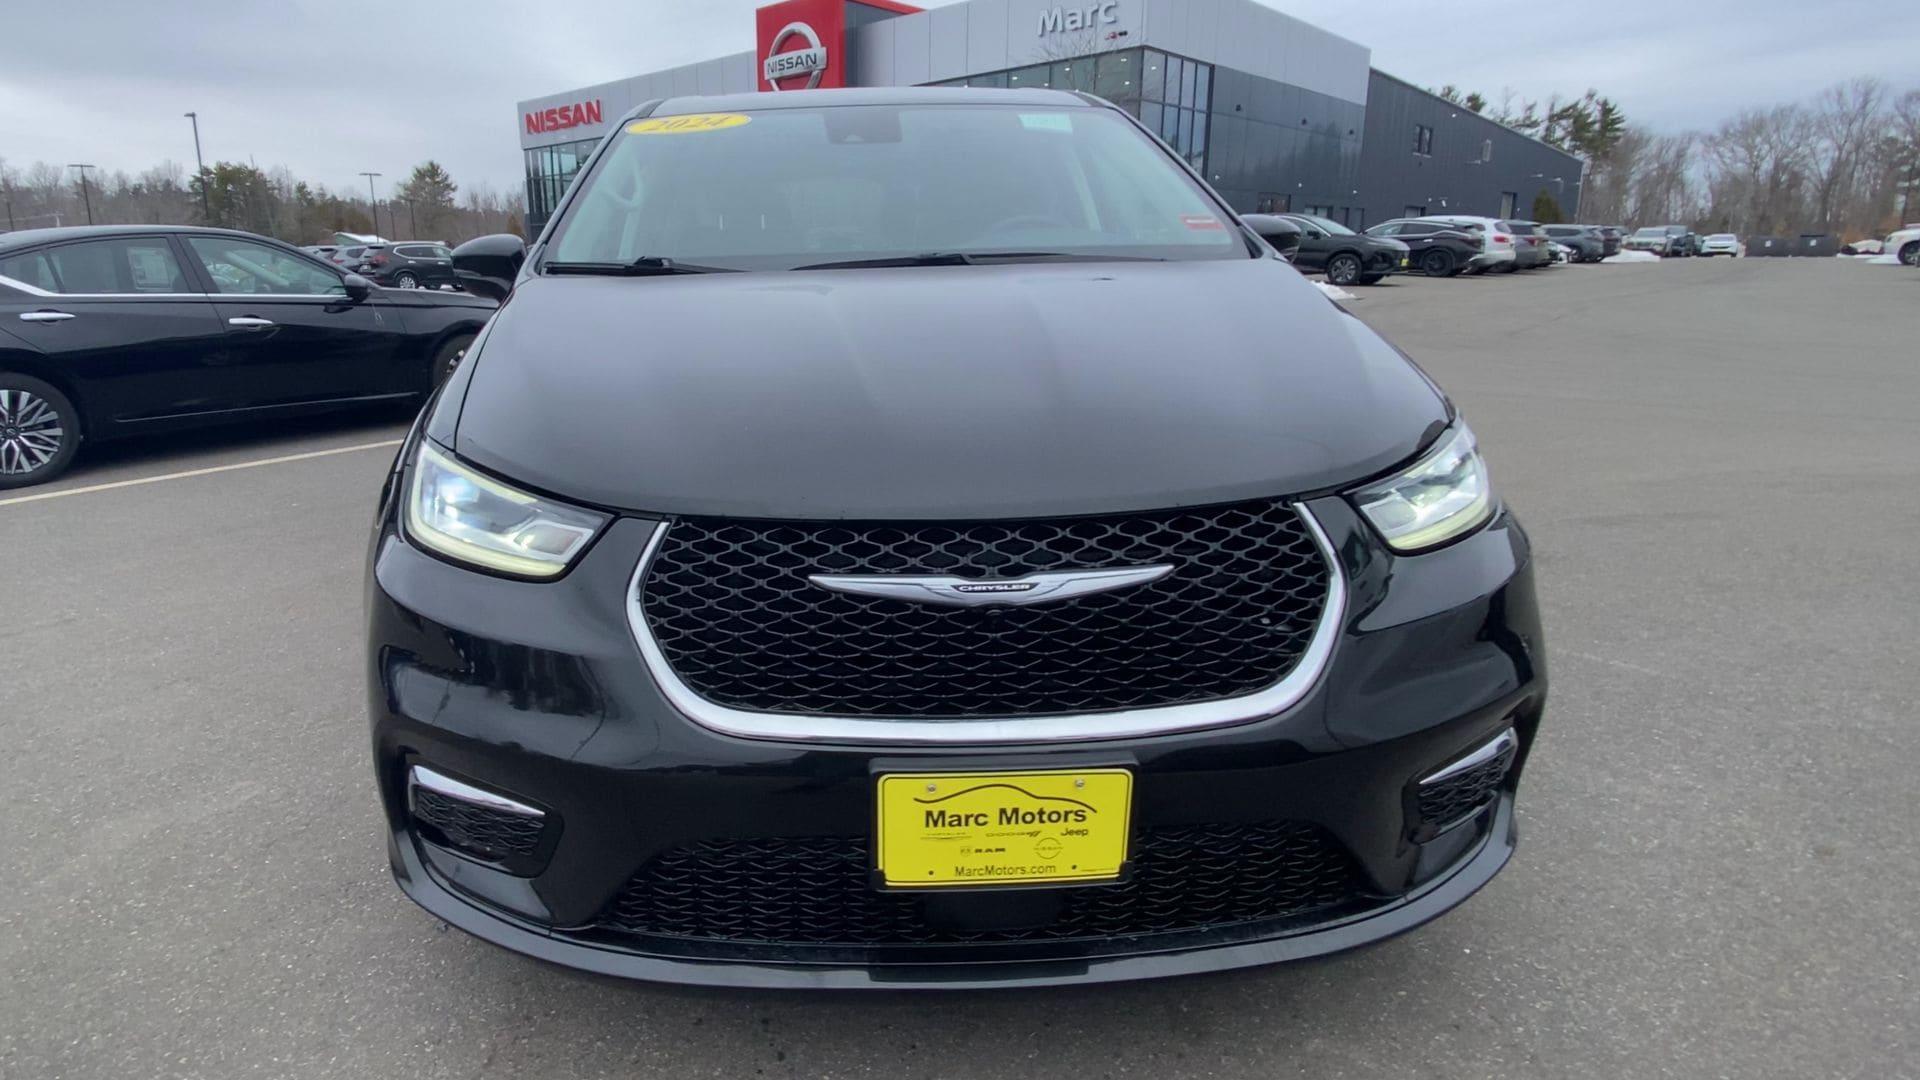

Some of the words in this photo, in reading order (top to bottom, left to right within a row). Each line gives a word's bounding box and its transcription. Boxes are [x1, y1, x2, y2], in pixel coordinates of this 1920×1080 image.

[1038, 0, 1117, 37] Marc
[767, 53, 817, 74] NISSAN
[526, 99, 603, 134] NISSAN
[925, 809, 989, 828] Marc
[998, 807, 1087, 826] Motors
[1060, 828, 1089, 837] Jeep
[955, 864, 1056, 877] MarcMotors.com
